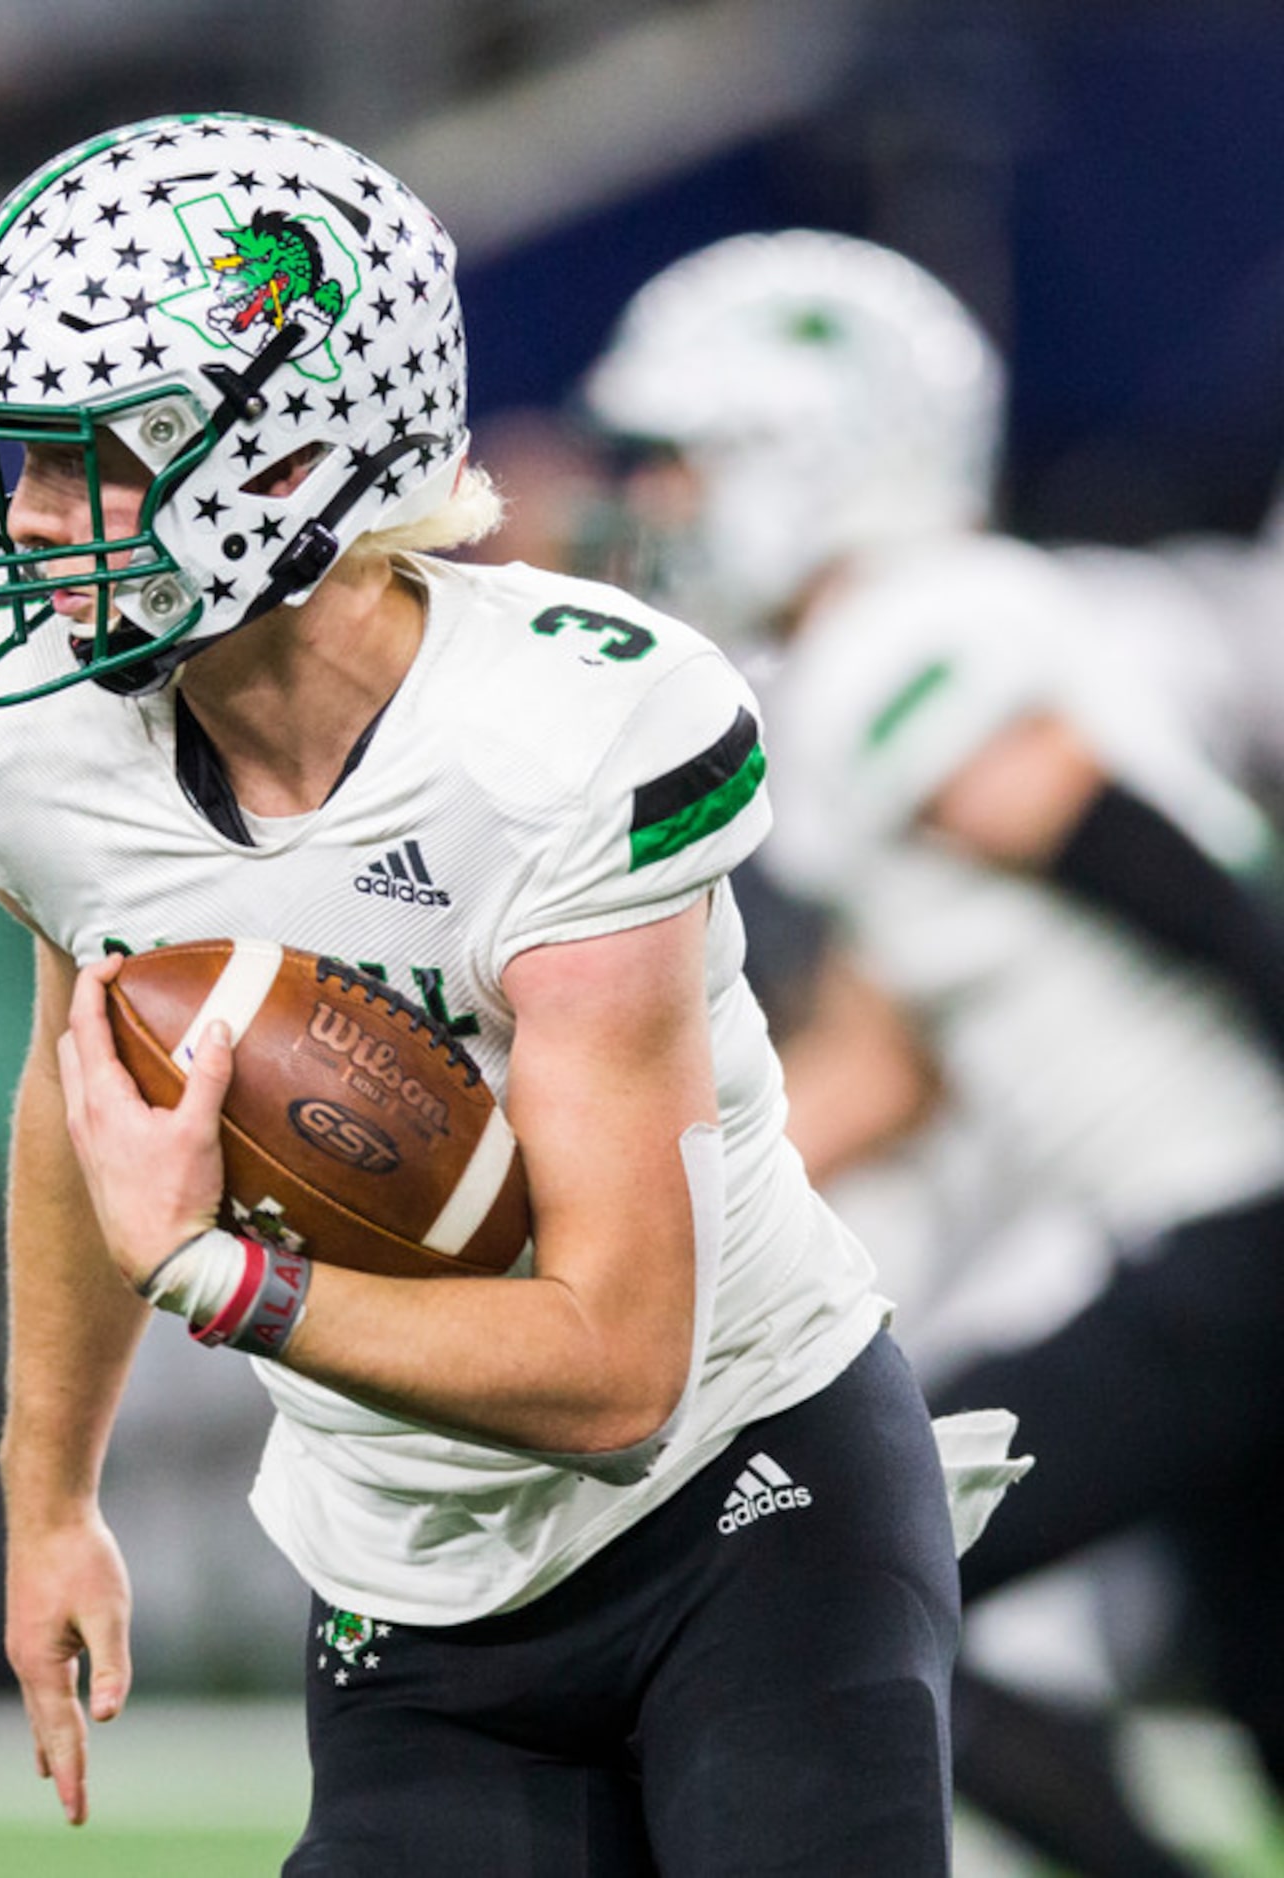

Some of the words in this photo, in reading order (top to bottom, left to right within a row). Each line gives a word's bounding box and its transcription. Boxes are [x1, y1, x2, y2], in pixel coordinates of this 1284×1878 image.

[530, 604, 657, 662] 3
[353, 874, 452, 908] adidas
[309, 1001, 450, 1137] Wilson
[299, 1101, 399, 1168] GST
[717, 1486, 813, 1535] adidas
